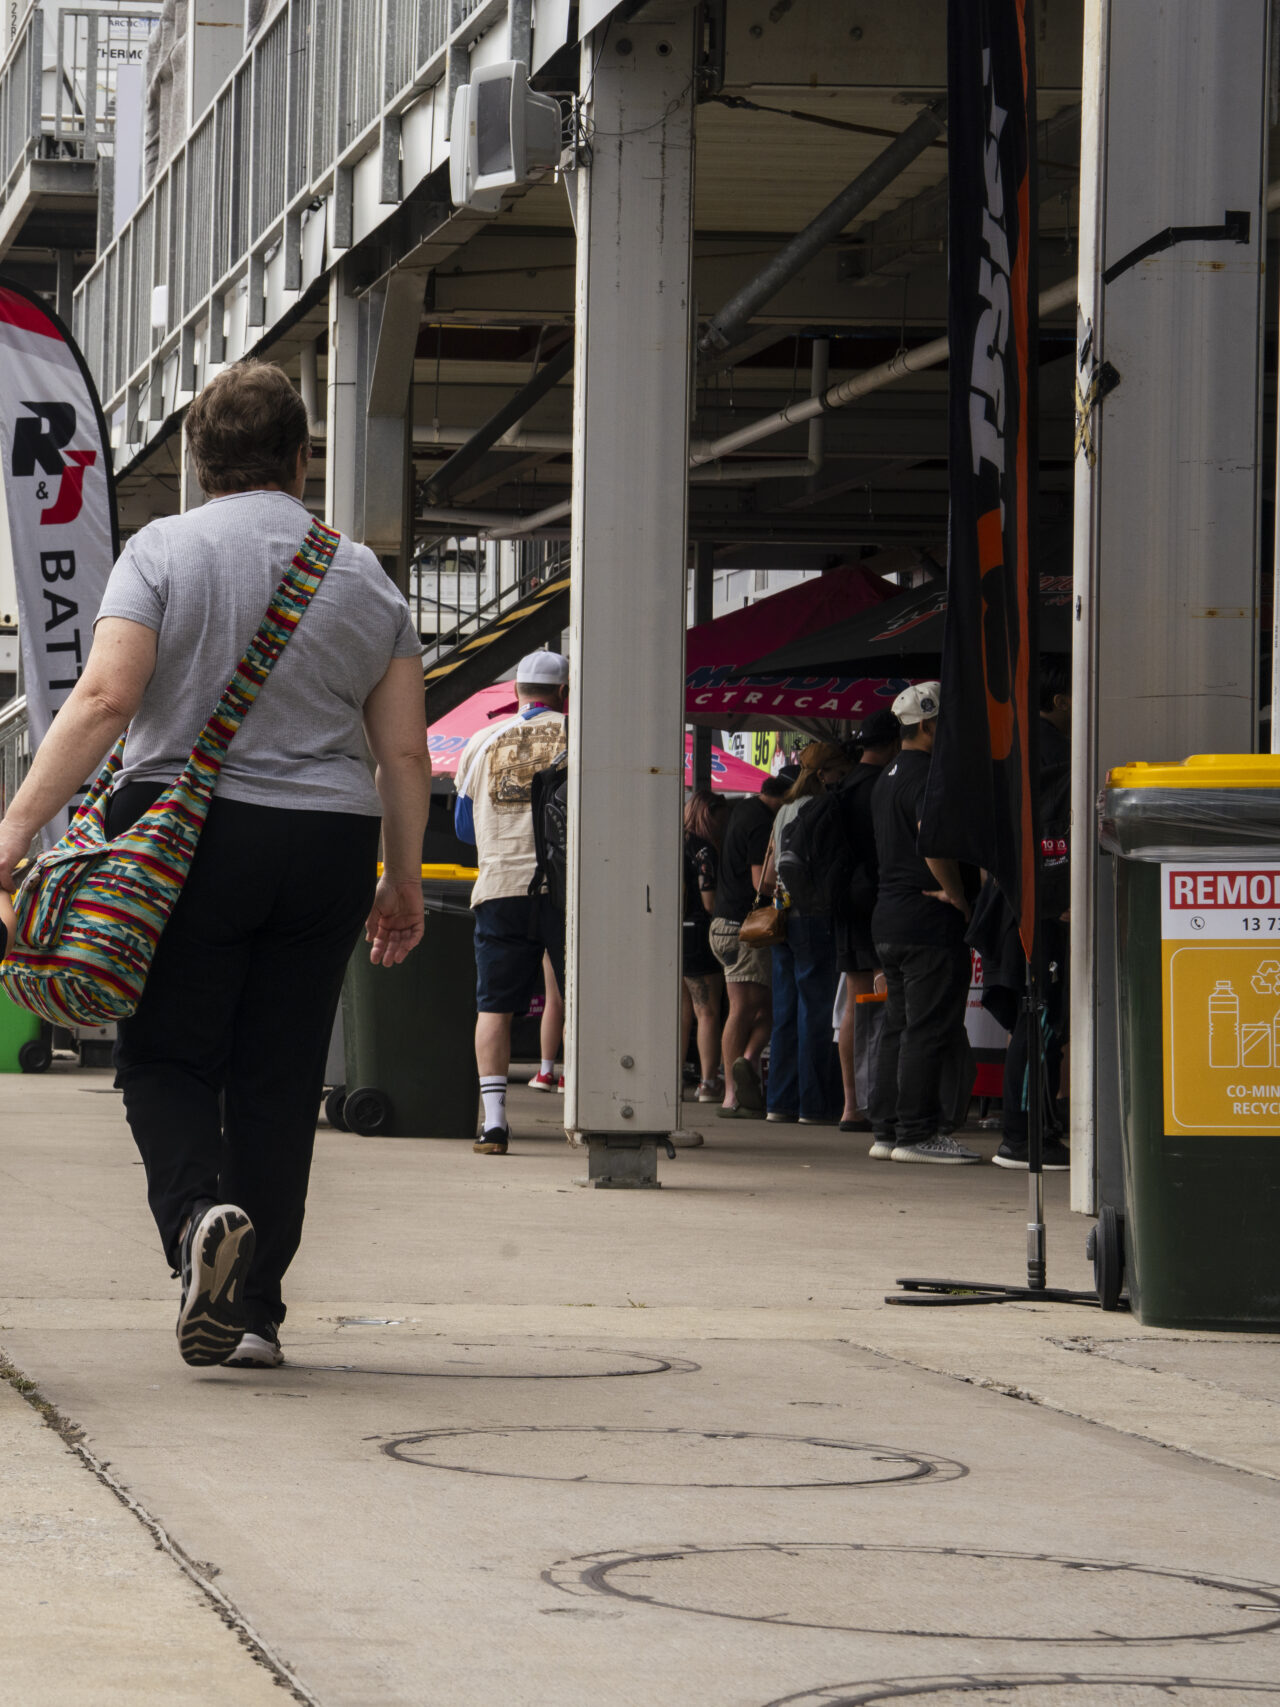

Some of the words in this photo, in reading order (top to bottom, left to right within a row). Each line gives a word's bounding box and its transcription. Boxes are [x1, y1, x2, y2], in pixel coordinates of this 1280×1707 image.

[40, 550, 86, 716] BATT
[754, 731, 770, 765] 96
[1174, 875, 1280, 905] REMO
[1243, 917, 1261, 931] 13
[1267, 917, 1280, 931] 7
[1233, 1102, 1280, 1115] RECYC
